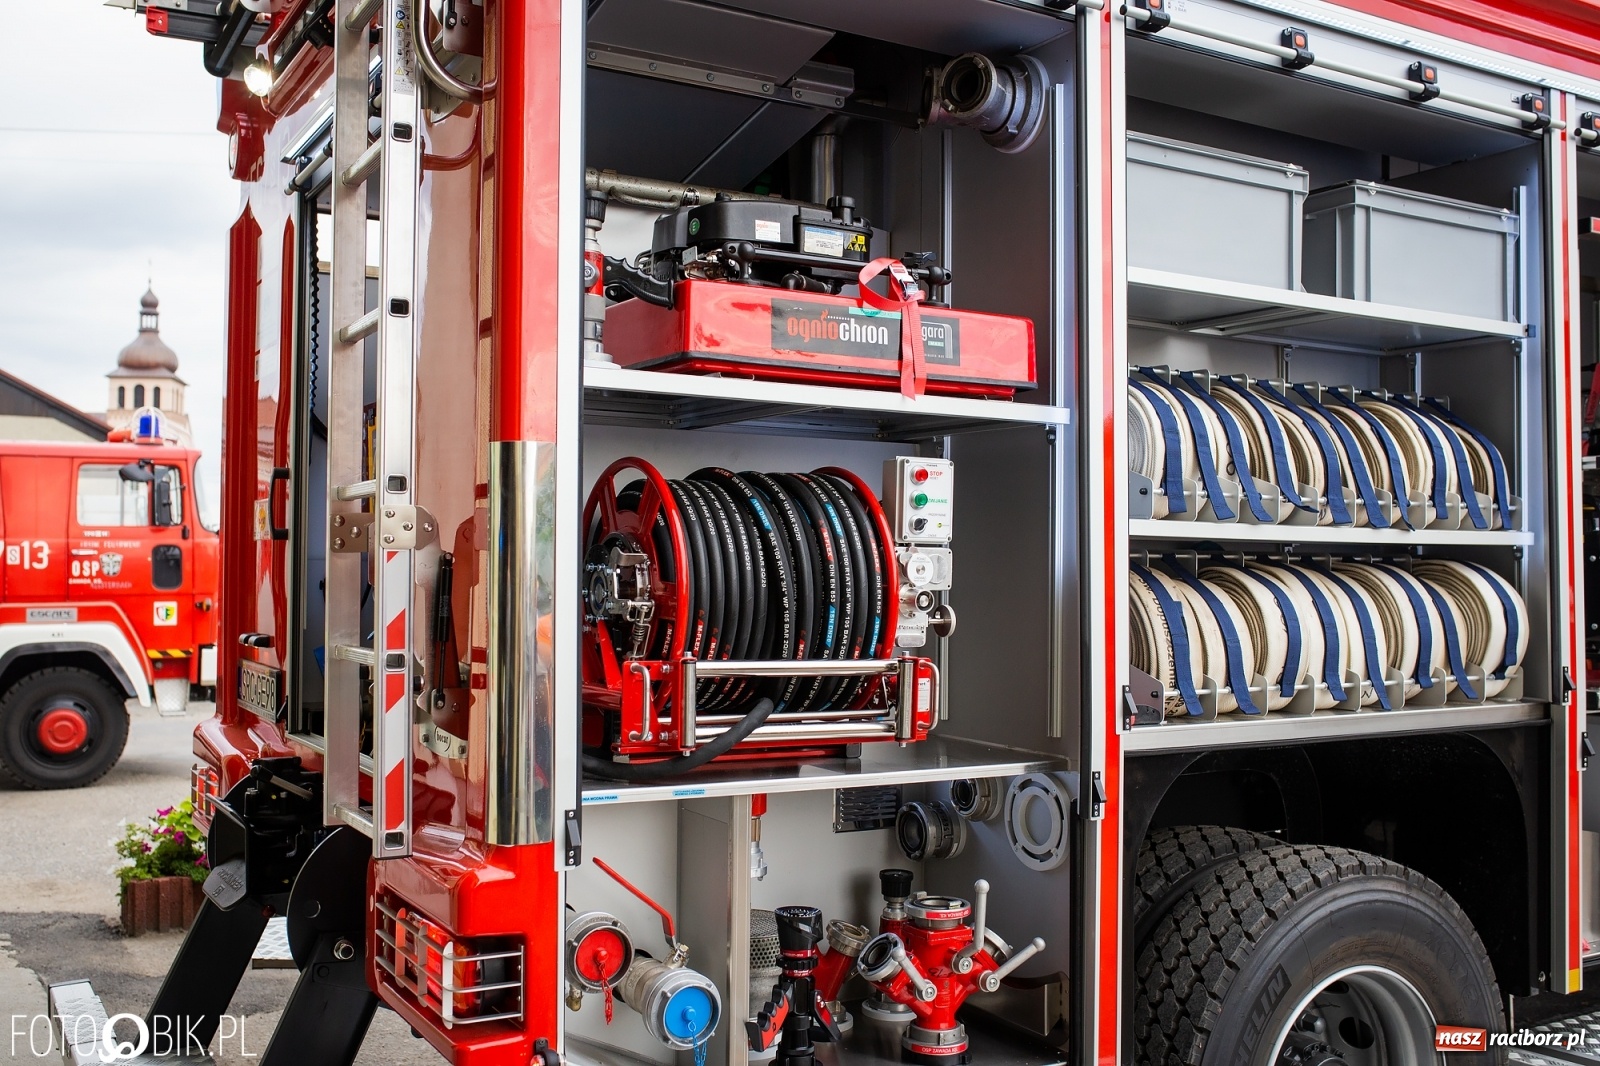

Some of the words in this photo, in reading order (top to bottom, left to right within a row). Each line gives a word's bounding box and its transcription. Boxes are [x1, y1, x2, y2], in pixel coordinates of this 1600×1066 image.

[787, 309, 888, 345] ogniochron
[921, 325, 944, 342] gara
[681, 496, 689, 506] BAR
[701, 506, 710, 518] BAR
[722, 520, 730, 533] BAR
[20, 540, 49, 570] 13
[72, 560, 100, 576] OSP
[776, 561, 785, 580] R1AT
[782, 596, 789, 608] WP
[830, 579, 835, 589] EN
[877, 589, 881, 600] EN
[846, 602, 851, 614] WP
[662, 628, 673, 653] M-FLEX
[693, 625, 703, 651] M-FLEX
[708, 642, 716, 660] M-FL
[436, 732, 449, 744] bocar
